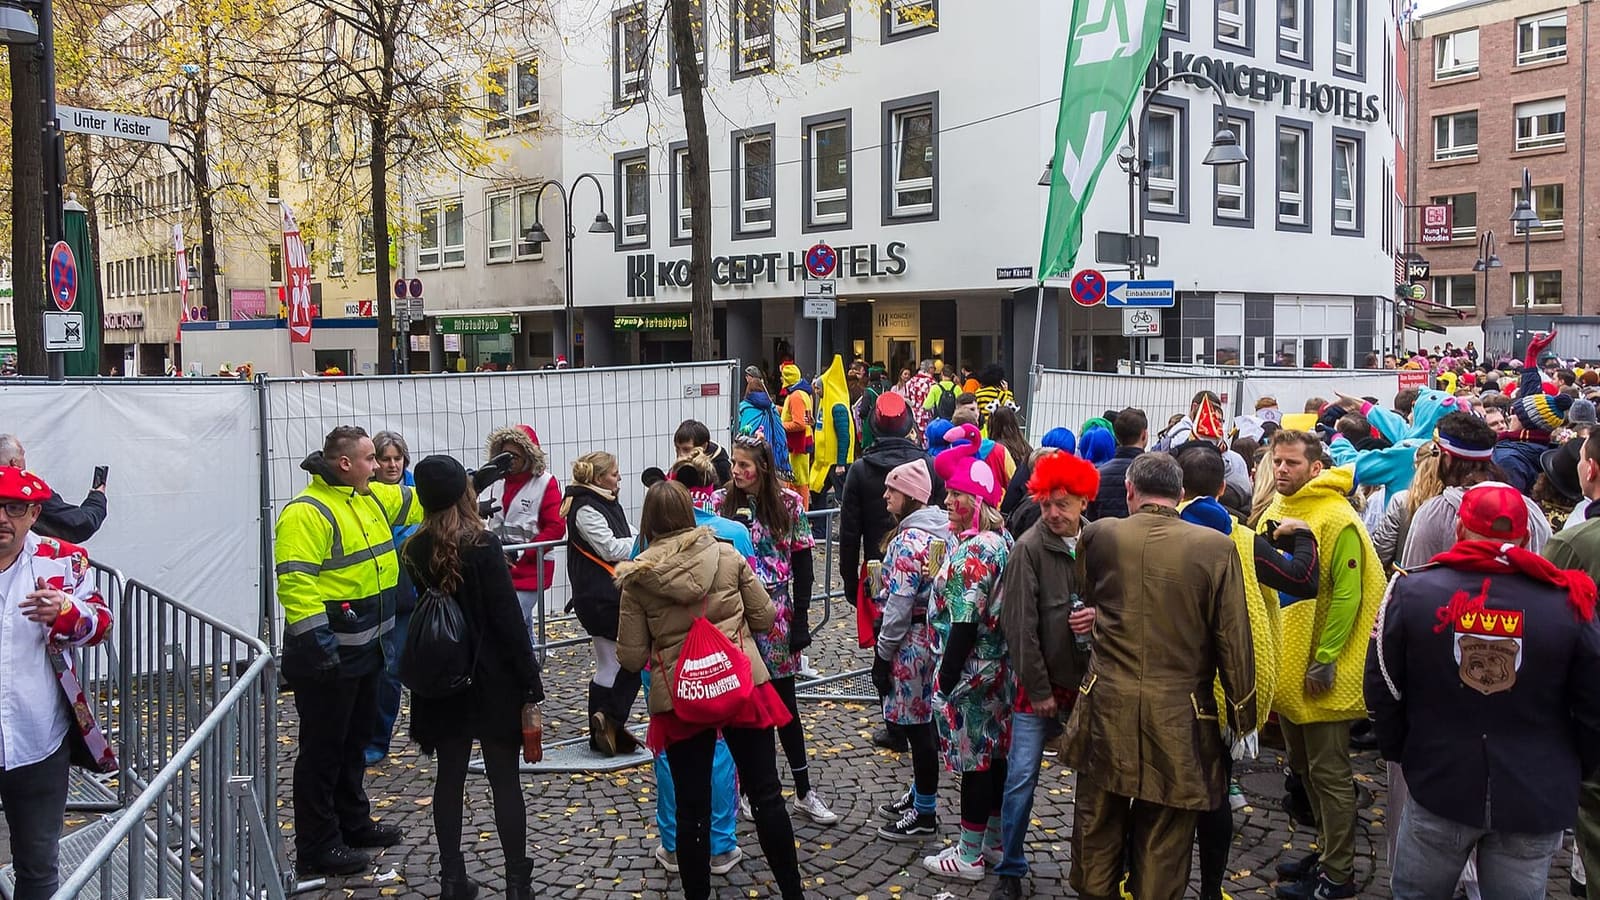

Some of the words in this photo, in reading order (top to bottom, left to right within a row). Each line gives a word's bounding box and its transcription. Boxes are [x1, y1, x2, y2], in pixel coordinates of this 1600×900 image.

[1173, 51, 1296, 106] KONCEPT
[1299, 79, 1379, 122] HOTELS
[74, 112, 106, 130] Unter
[114, 117, 151, 136] Käster
[1422, 234, 1450, 242] Noodles
[658, 252, 782, 287] KOCEPT
[788, 241, 907, 282] HTELS
[1409, 265, 1427, 277] sky
[997, 269, 1012, 278] Unter
[1012, 268, 1031, 277] Käster
[1125, 289, 1170, 297] Einbahnstraße
[454, 318, 499, 332] Altstadtpub
[645, 317, 688, 330] tstadtpub
[677, 679, 704, 700] HEISS
[709, 679, 741, 698] MEDIZIN
